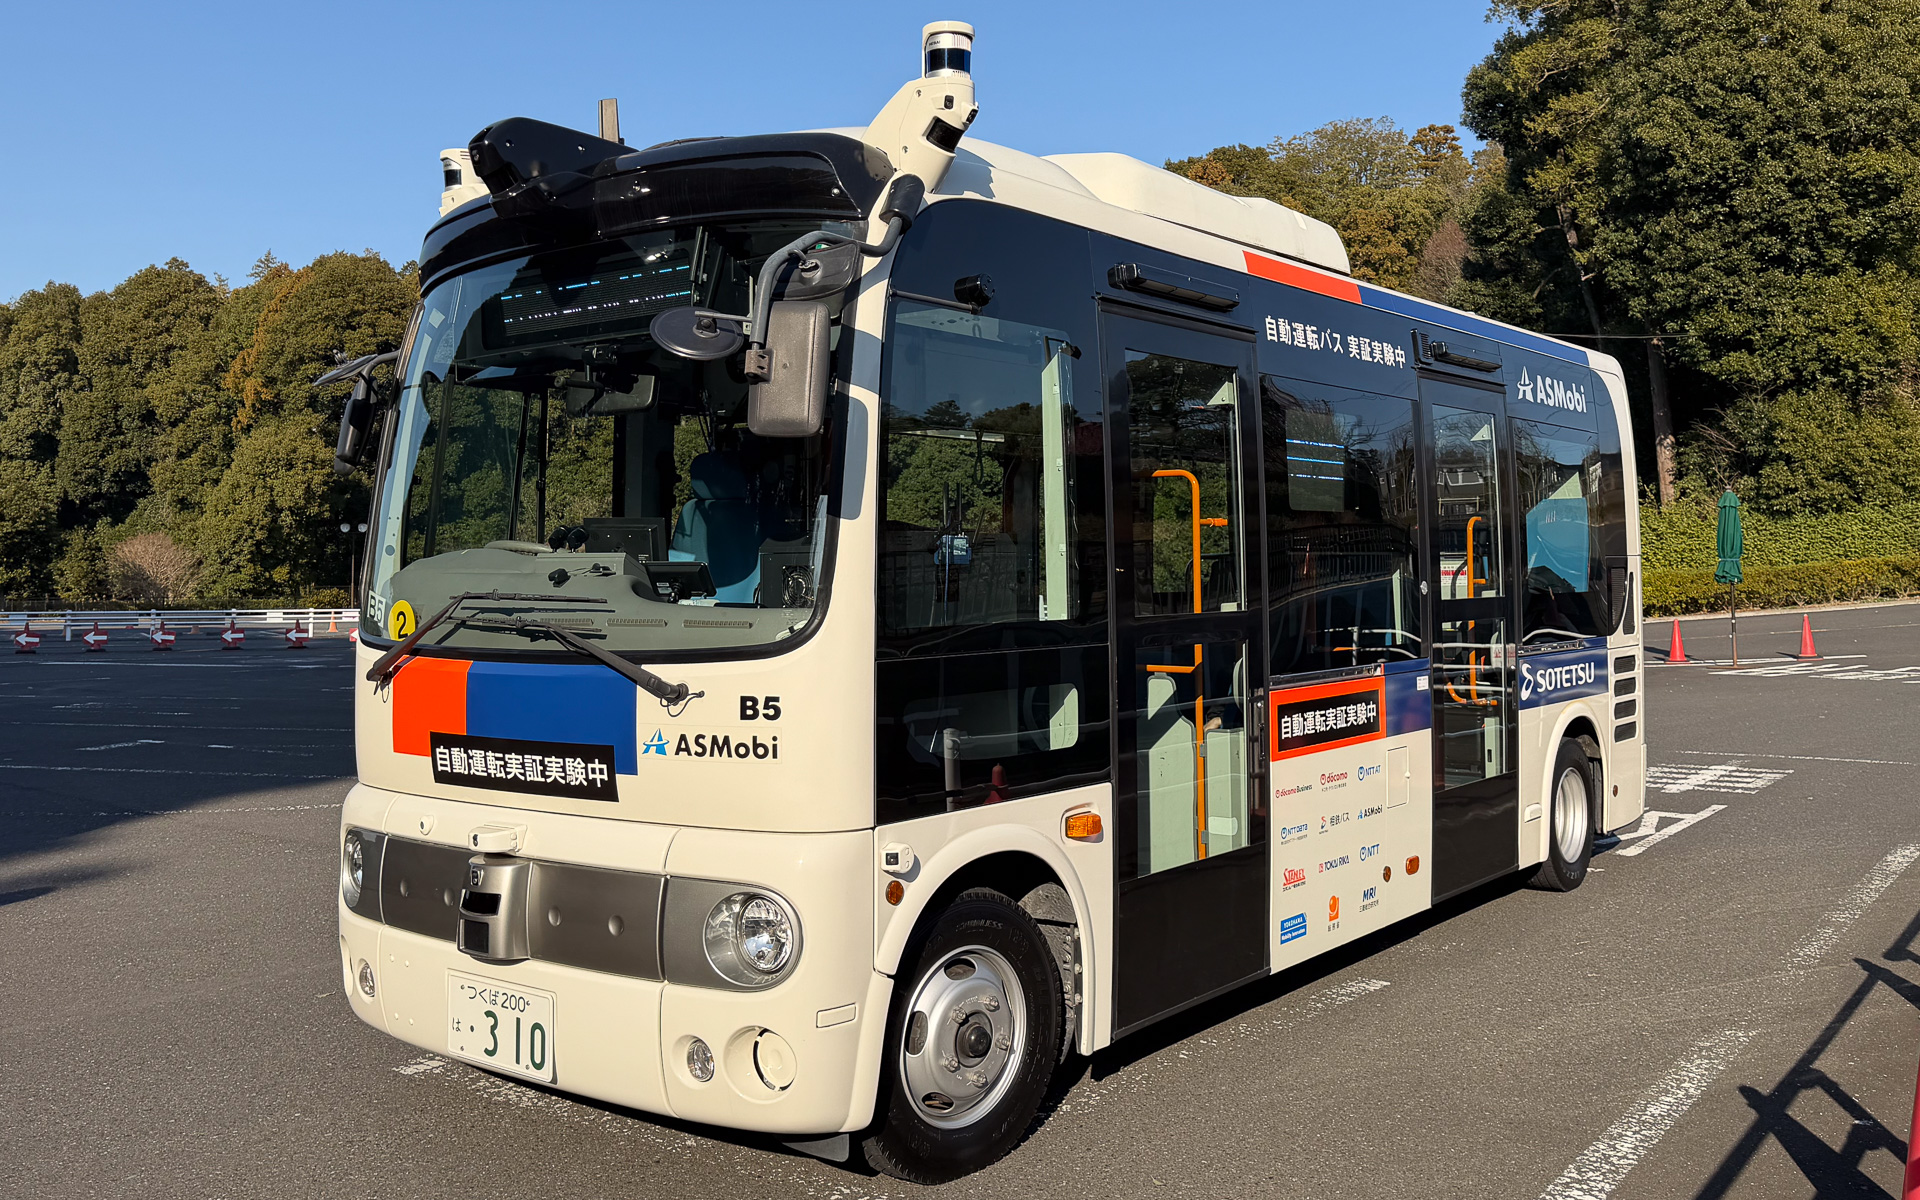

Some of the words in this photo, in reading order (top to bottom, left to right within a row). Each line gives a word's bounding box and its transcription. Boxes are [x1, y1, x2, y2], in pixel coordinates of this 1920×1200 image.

[1265, 315, 1344, 354] 自動運転バス
[1347, 335, 1406, 369] 実証実験中
[1536, 374, 1587, 414] ASMobi
[369, 594, 383, 624] B5
[396, 610, 409, 639] 2
[1536, 661, 1595, 693] SOTETSU
[739, 695, 782, 721] B5
[1281, 701, 1377, 740] 自動運転実証実験中
[674, 732, 779, 760] ASMobi
[435, 745, 609, 788] 自動運転実証実験中
[1363, 804, 1383, 818] ASMobi
[1367, 844, 1380, 858] NTT
[1362, 886, 1377, 903] MRI
[452, 1017, 461, 1032] は
